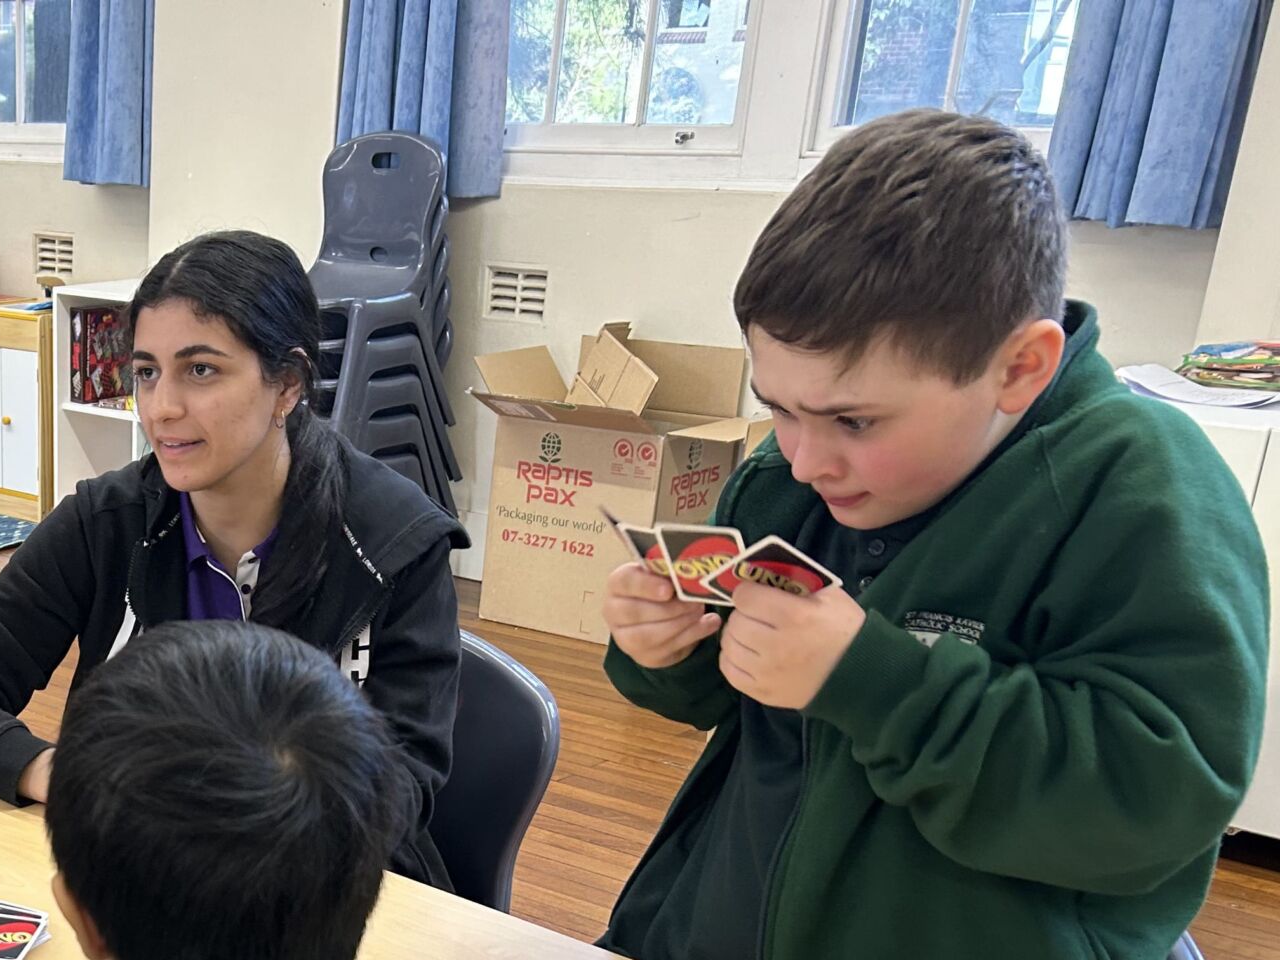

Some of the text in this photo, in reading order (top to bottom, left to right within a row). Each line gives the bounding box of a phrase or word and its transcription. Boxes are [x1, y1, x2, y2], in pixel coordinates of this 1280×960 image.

[551, 515, 570, 528] our
[502, 529, 595, 557] 07-3277 1622
